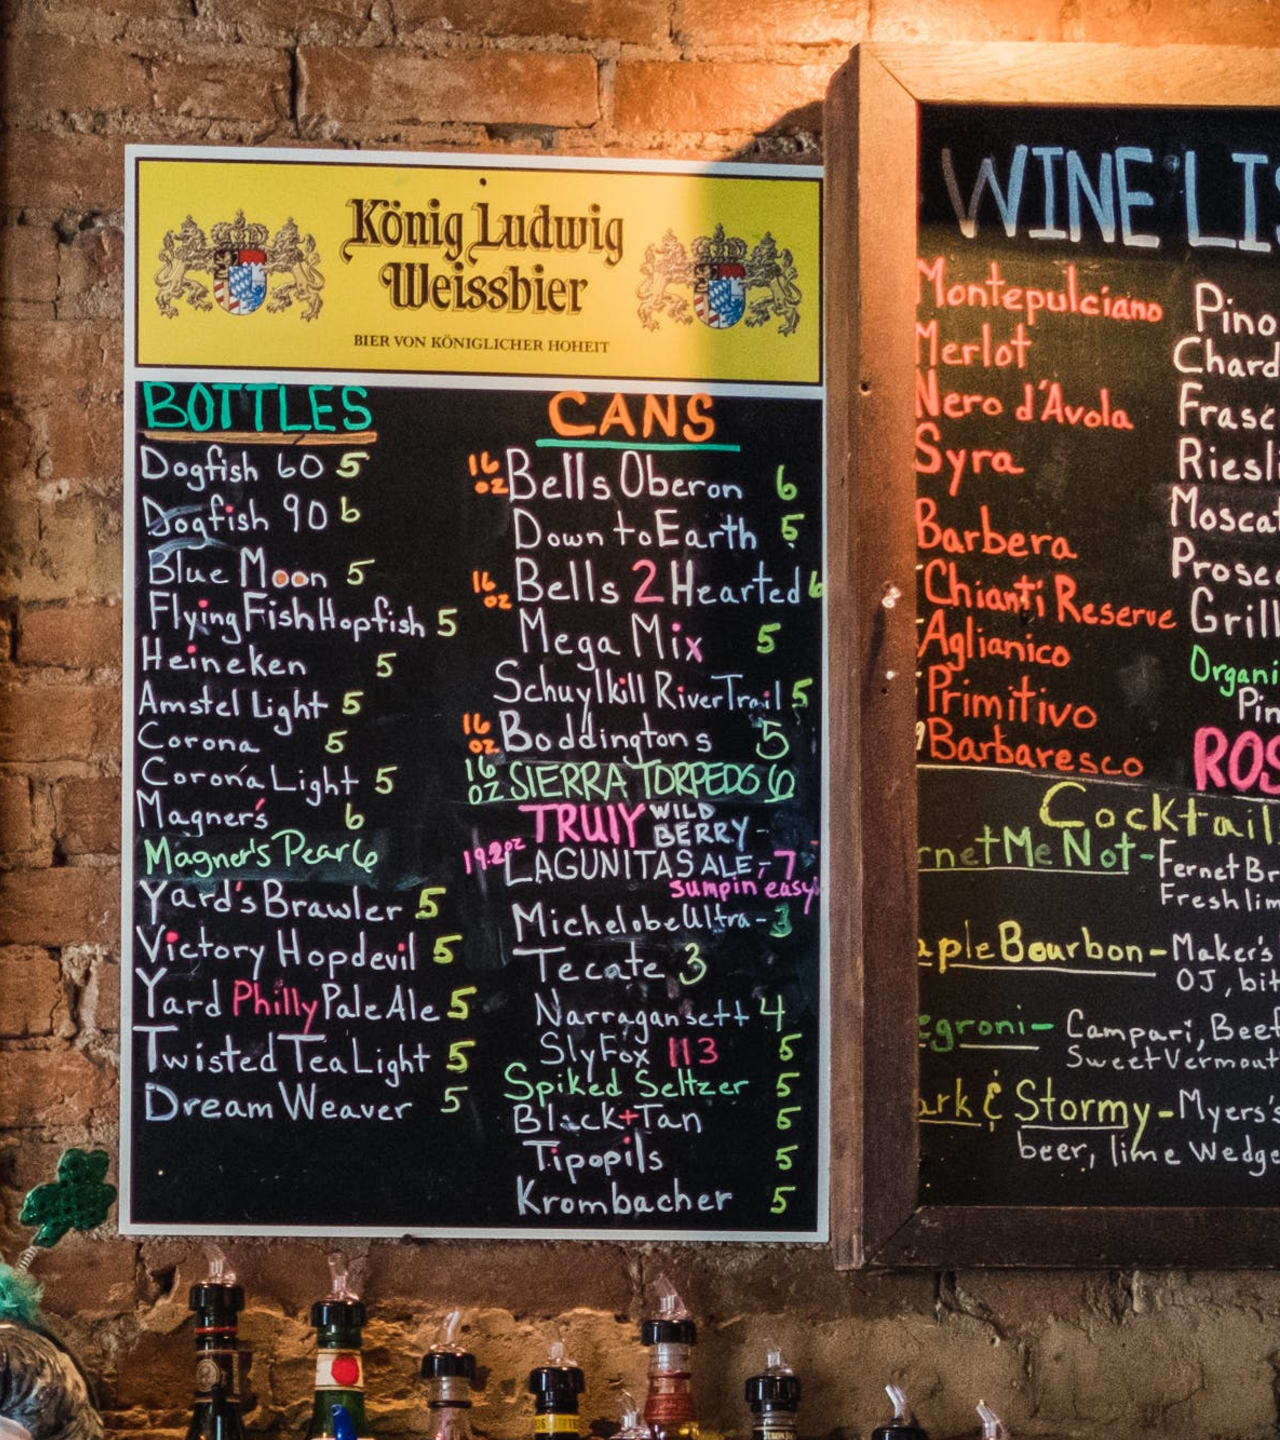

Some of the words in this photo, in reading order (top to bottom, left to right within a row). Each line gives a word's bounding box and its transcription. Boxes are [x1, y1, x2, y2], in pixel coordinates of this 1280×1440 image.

[942, 144, 1160, 248] WINE
[1186, 148, 1280, 252] LI
[341, 198, 463, 263] König
[466, 202, 624, 266] Ludwig
[380, 261, 587, 314] Weissbier
[916, 256, 1163, 325] Montepulciano
[354, 334, 389, 347] BIER
[394, 335, 426, 347] VON
[431, 335, 543, 351] KÖNIGLICHER
[548, 340, 609, 353] HOHEIT
[916, 320, 1032, 368] Merlot
[143, 383, 372, 432] BOTTLES
[548, 392, 715, 442] CANS
[915, 369, 1002, 419] Nero
[1016, 380, 1134, 429] d'Avola
[142, 446, 257, 490] Dogfish
[278, 454, 323, 480] 60
[507, 449, 611, 502] Bells
[618, 451, 743, 500] Oberon
[914, 422, 1024, 495] Syra
[144, 496, 269, 536] Dogfish
[288, 496, 328, 533] 90
[514, 510, 603, 548] Down
[615, 514, 654, 546] to
[656, 511, 757, 551] Earth
[915, 497, 1078, 559] Barbera
[148, 549, 229, 587] Blue
[241, 549, 329, 590] Moon
[516, 561, 619, 604] Bells
[631, 561, 664, 602] 2
[670, 562, 801, 606] Hearted
[151, 594, 240, 641] Flying
[243, 593, 316, 632] Fish
[320, 599, 426, 641] Hopfish
[924, 559, 1045, 617] Chianti
[1054, 574, 1177, 629] Reserve
[142, 643, 307, 675] Heineken
[519, 607, 621, 670] Mega
[631, 607, 704, 662] Mix
[917, 610, 1071, 672] Aglianico
[139, 682, 240, 716] Amstel
[252, 690, 329, 735] Light
[493, 660, 646, 733] Schuylkill
[655, 671, 719, 709] River
[711, 674, 782, 711] Trail
[928, 665, 1098, 729] Primitivo
[138, 722, 260, 753] Corona
[499, 710, 712, 768] Boddingtons
[928, 717, 1144, 777] Barbaresco
[142, 757, 266, 789] Corona
[271, 765, 360, 806] Light
[509, 761, 629, 801] SIERRA
[137, 790, 268, 836] Magner's
[518, 803, 646, 848] TRULY
[649, 804, 716, 820] WILD
[654, 816, 749, 851] BERRY
[144, 839, 272, 877] Magner's
[271, 829, 351, 866] Pear
[504, 849, 694, 887] LAGUNITAS
[701, 854, 753, 879] ALE
[1063, 828, 1137, 870] Not
[1159, 838, 1240, 880] Fernet
[141, 880, 257, 924] Yard's
[264, 880, 403, 921] Brawler
[1160, 883, 1239, 909] Fresh
[512, 903, 678, 941] Michelobe
[998, 920, 1142, 962] Bourbon
[137, 925, 265, 980] Victory
[278, 928, 416, 978] Hopdevil
[513, 941, 665, 982] Tecate
[137, 969, 221, 1018] Yard
[233, 981, 319, 1034] Philly
[323, 986, 382, 1021] Pale
[386, 987, 440, 1022] Ale
[534, 988, 750, 1044] Narragansett
[133, 1026, 278, 1073] Twisted
[277, 1034, 346, 1073] Tea
[354, 1040, 431, 1086] Light
[541, 1031, 596, 1082] Sly
[599, 1034, 650, 1067] Fox
[668, 1037, 719, 1067] 113
[1066, 1046, 1161, 1070] Sweet
[146, 1084, 274, 1121] Dream
[278, 1082, 413, 1121] Weaver
[504, 1062, 622, 1106] Spiked
[635, 1069, 750, 1098] Seltzer
[1016, 1077, 1151, 1150] Stormy
[523, 1129, 664, 1184] Tipopils
[1018, 1131, 1096, 1169] beer,
[1111, 1134, 1181, 1167] lime
[517, 1176, 732, 1216] Krombacher
